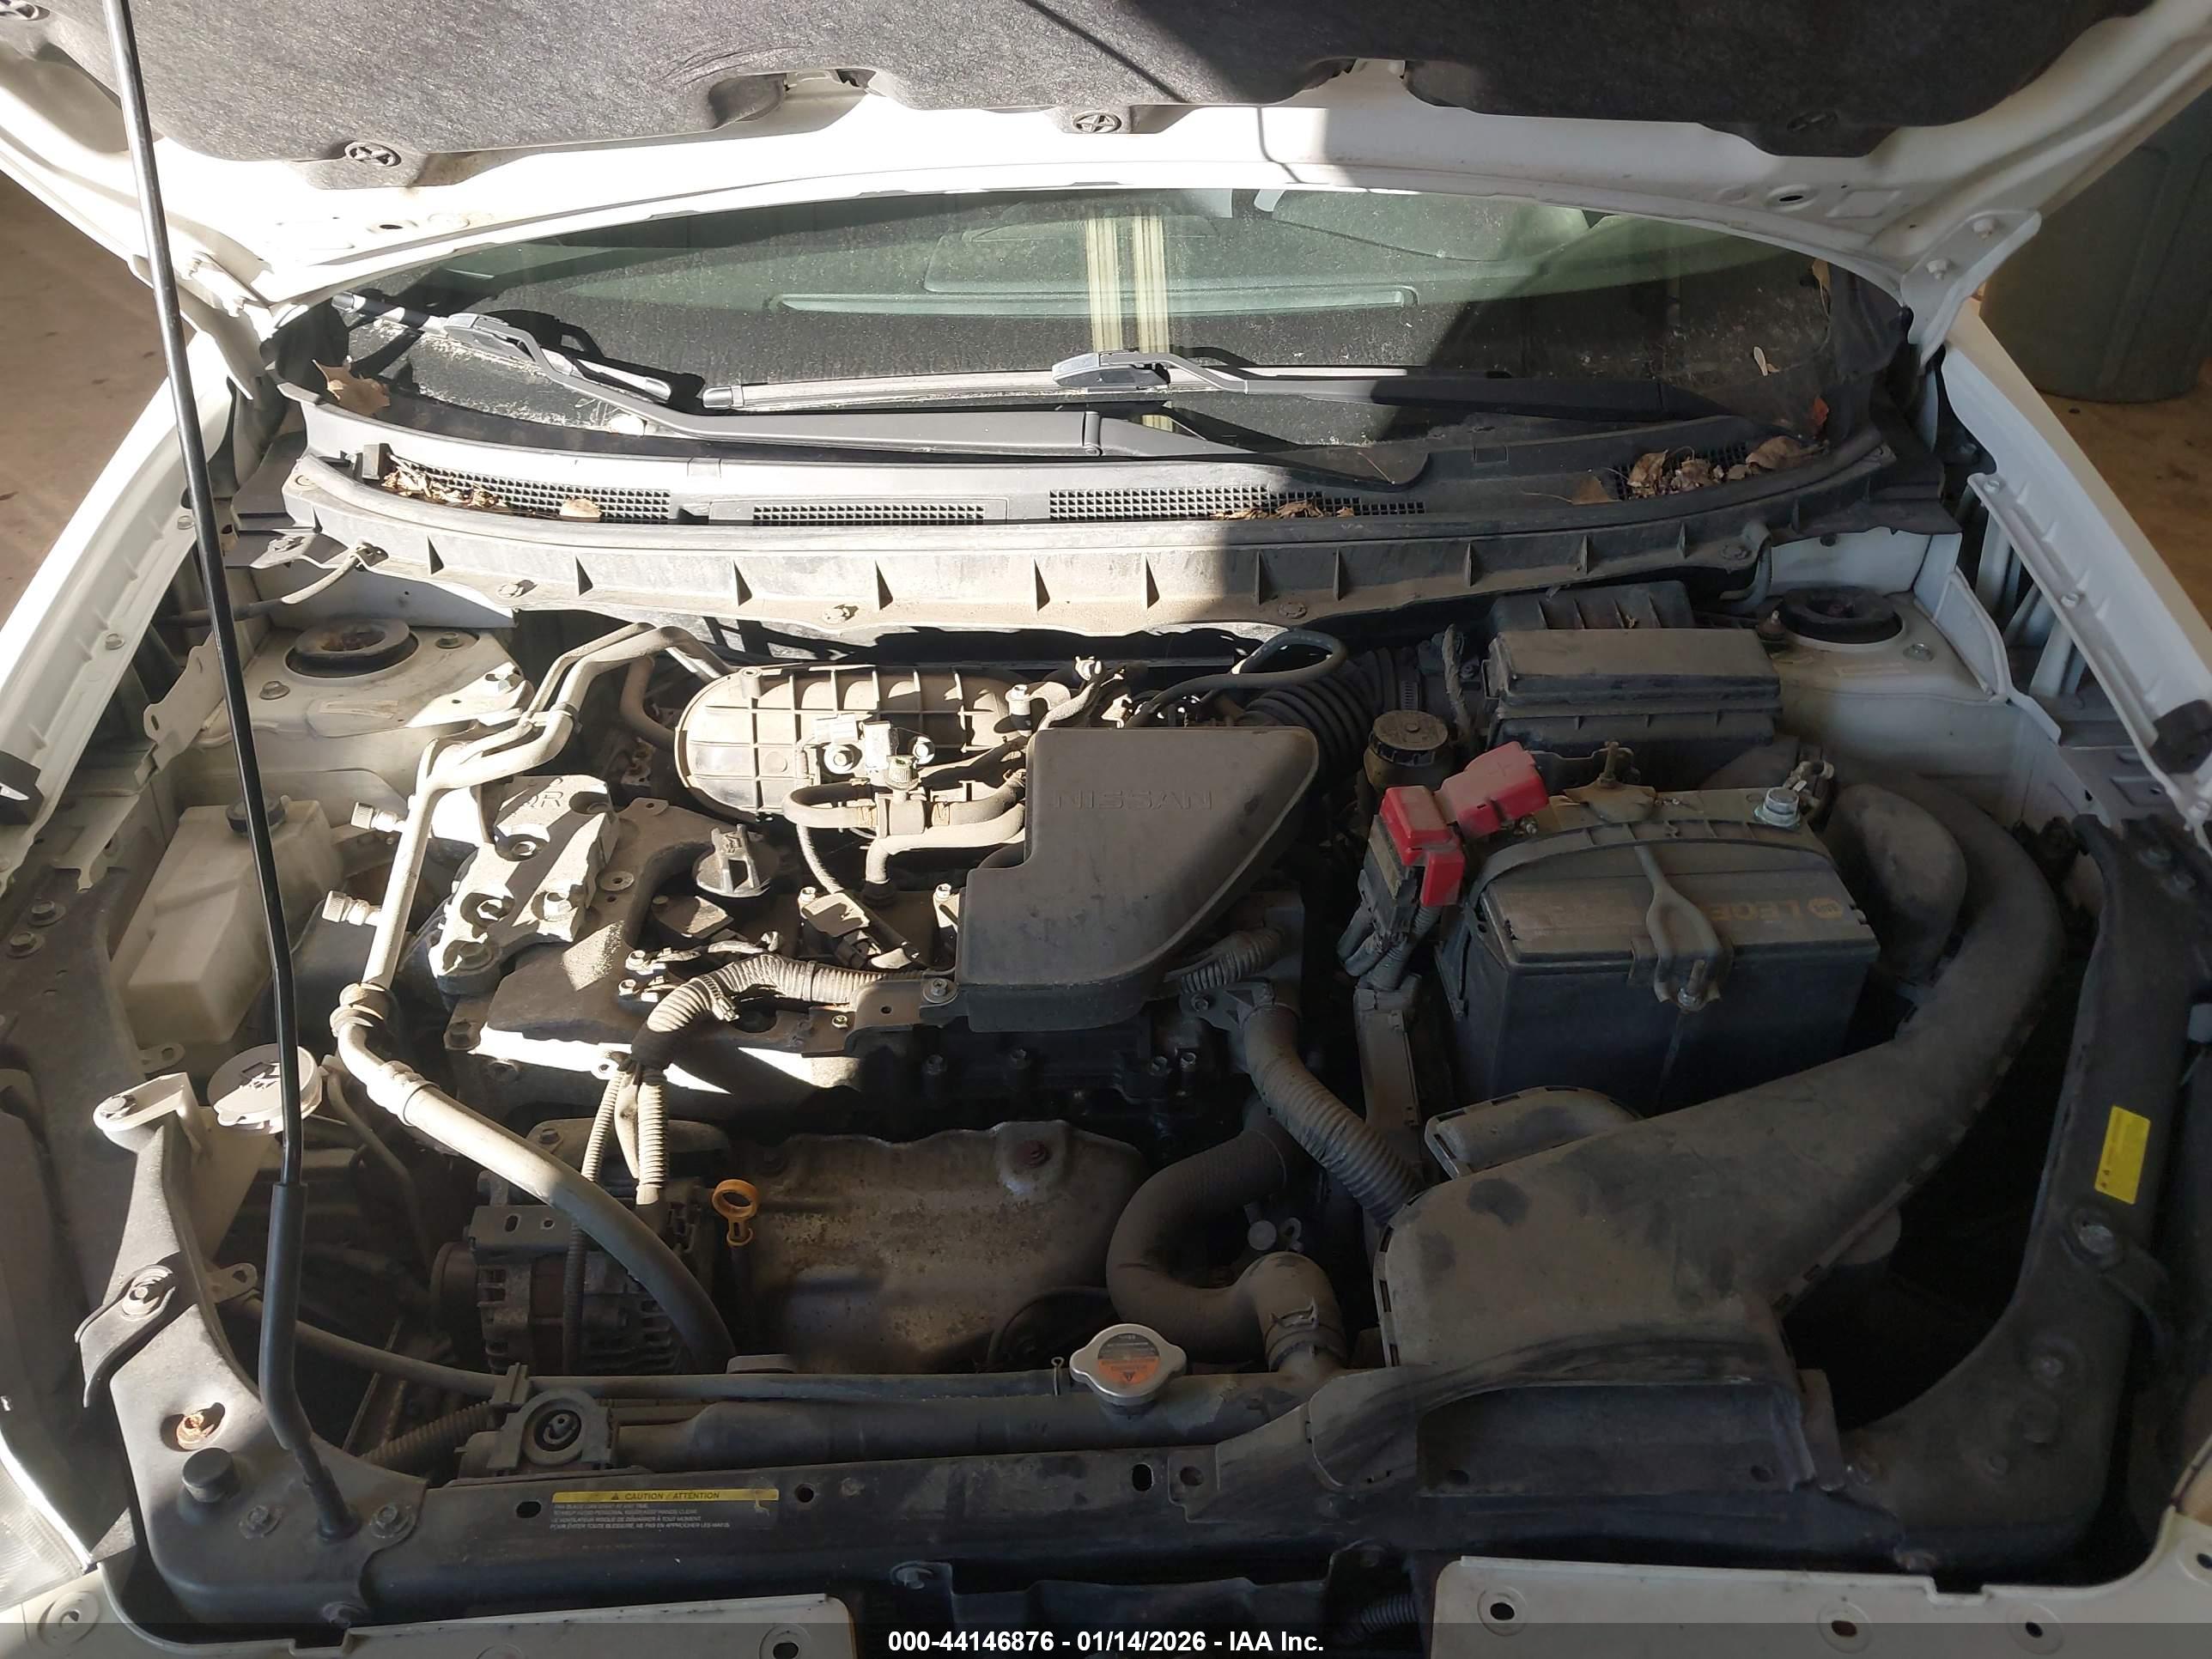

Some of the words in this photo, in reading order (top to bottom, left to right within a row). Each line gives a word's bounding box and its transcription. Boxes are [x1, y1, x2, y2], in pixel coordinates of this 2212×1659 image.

[1053, 789, 1213, 811] NISSAN
[624, 1492, 664, 1501] CAUTION
[672, 1492, 720, 1500] ATTENTION
